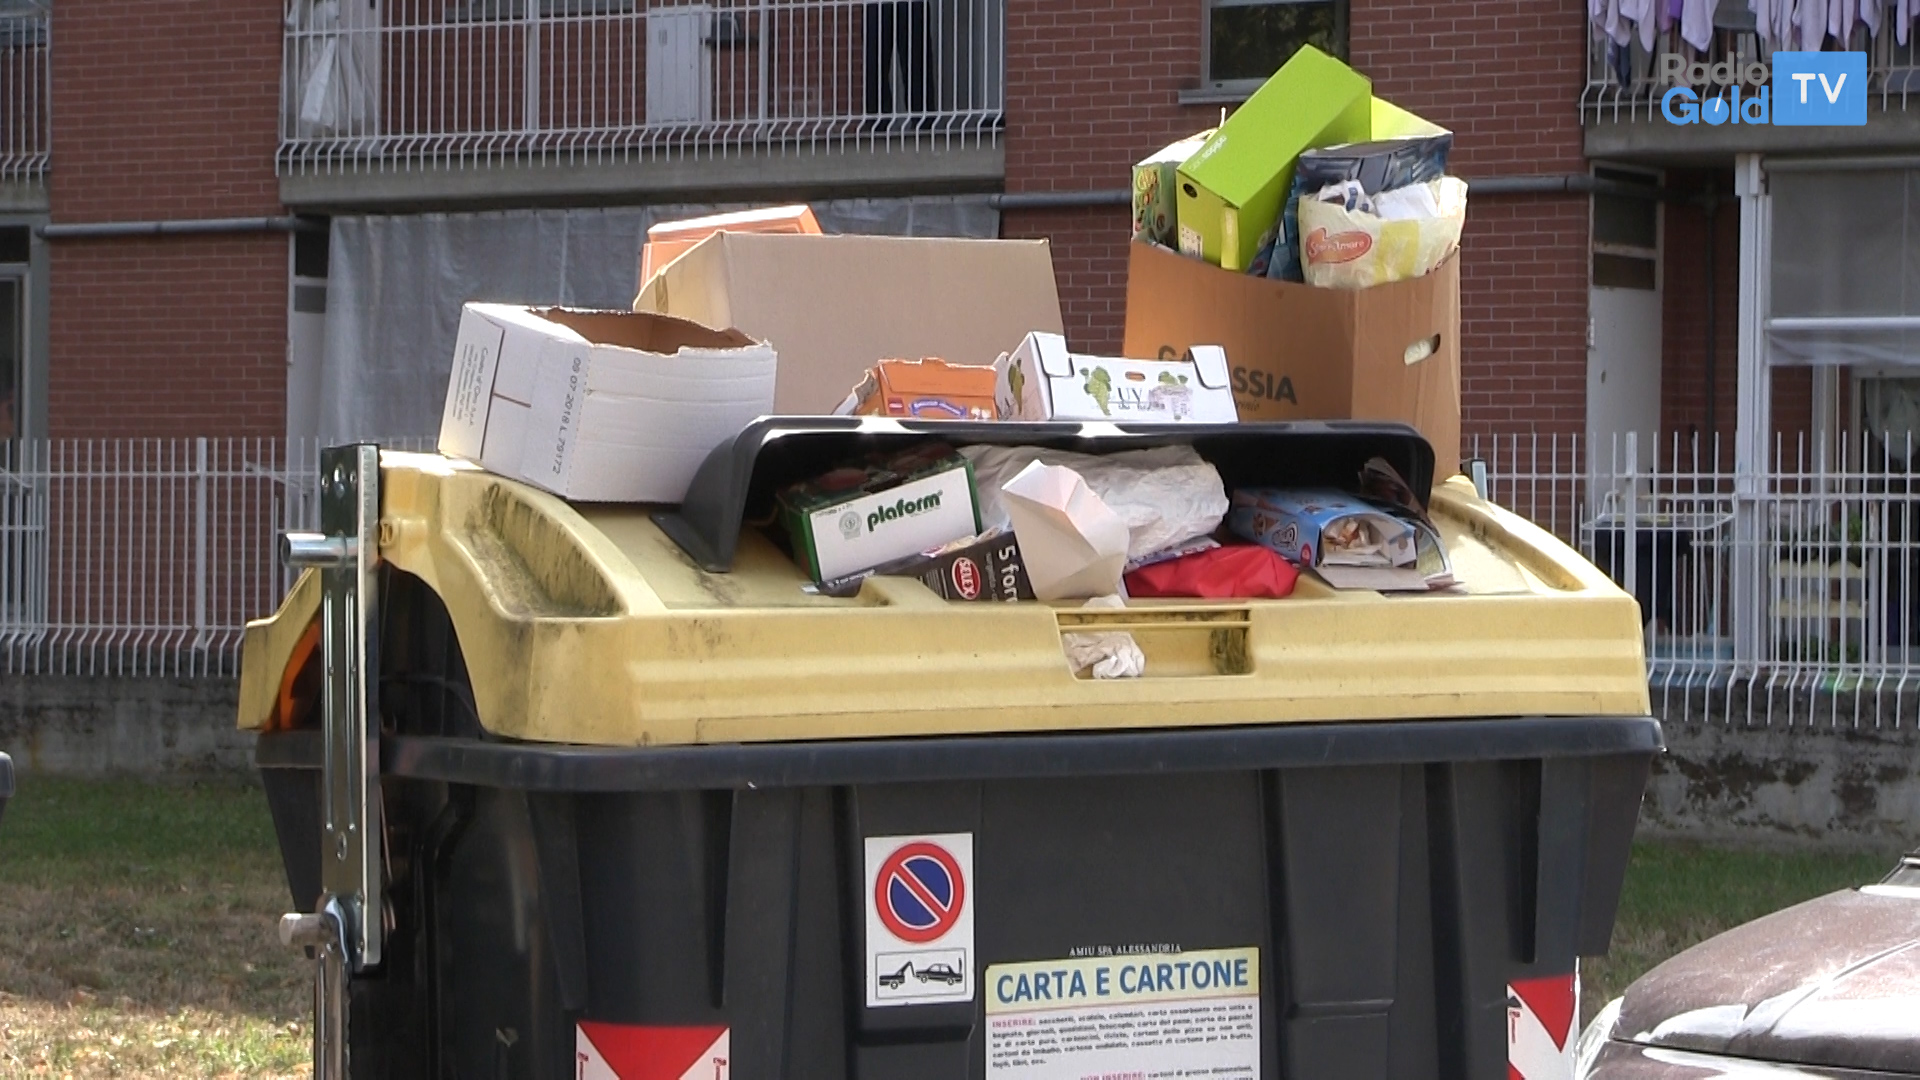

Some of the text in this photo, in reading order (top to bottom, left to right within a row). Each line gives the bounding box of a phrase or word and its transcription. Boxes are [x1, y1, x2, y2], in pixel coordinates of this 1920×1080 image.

[569, 375, 578, 392] 07
[562, 393, 574, 424] 2018
[998, 545, 1016, 561] 5
[959, 559, 976, 598] SELEX
[1069, 945, 1095, 957] AMIU
[1116, 943, 1182, 955] ALESSANDRIA
[996, 958, 1249, 1004] CARTA E CARTONE
